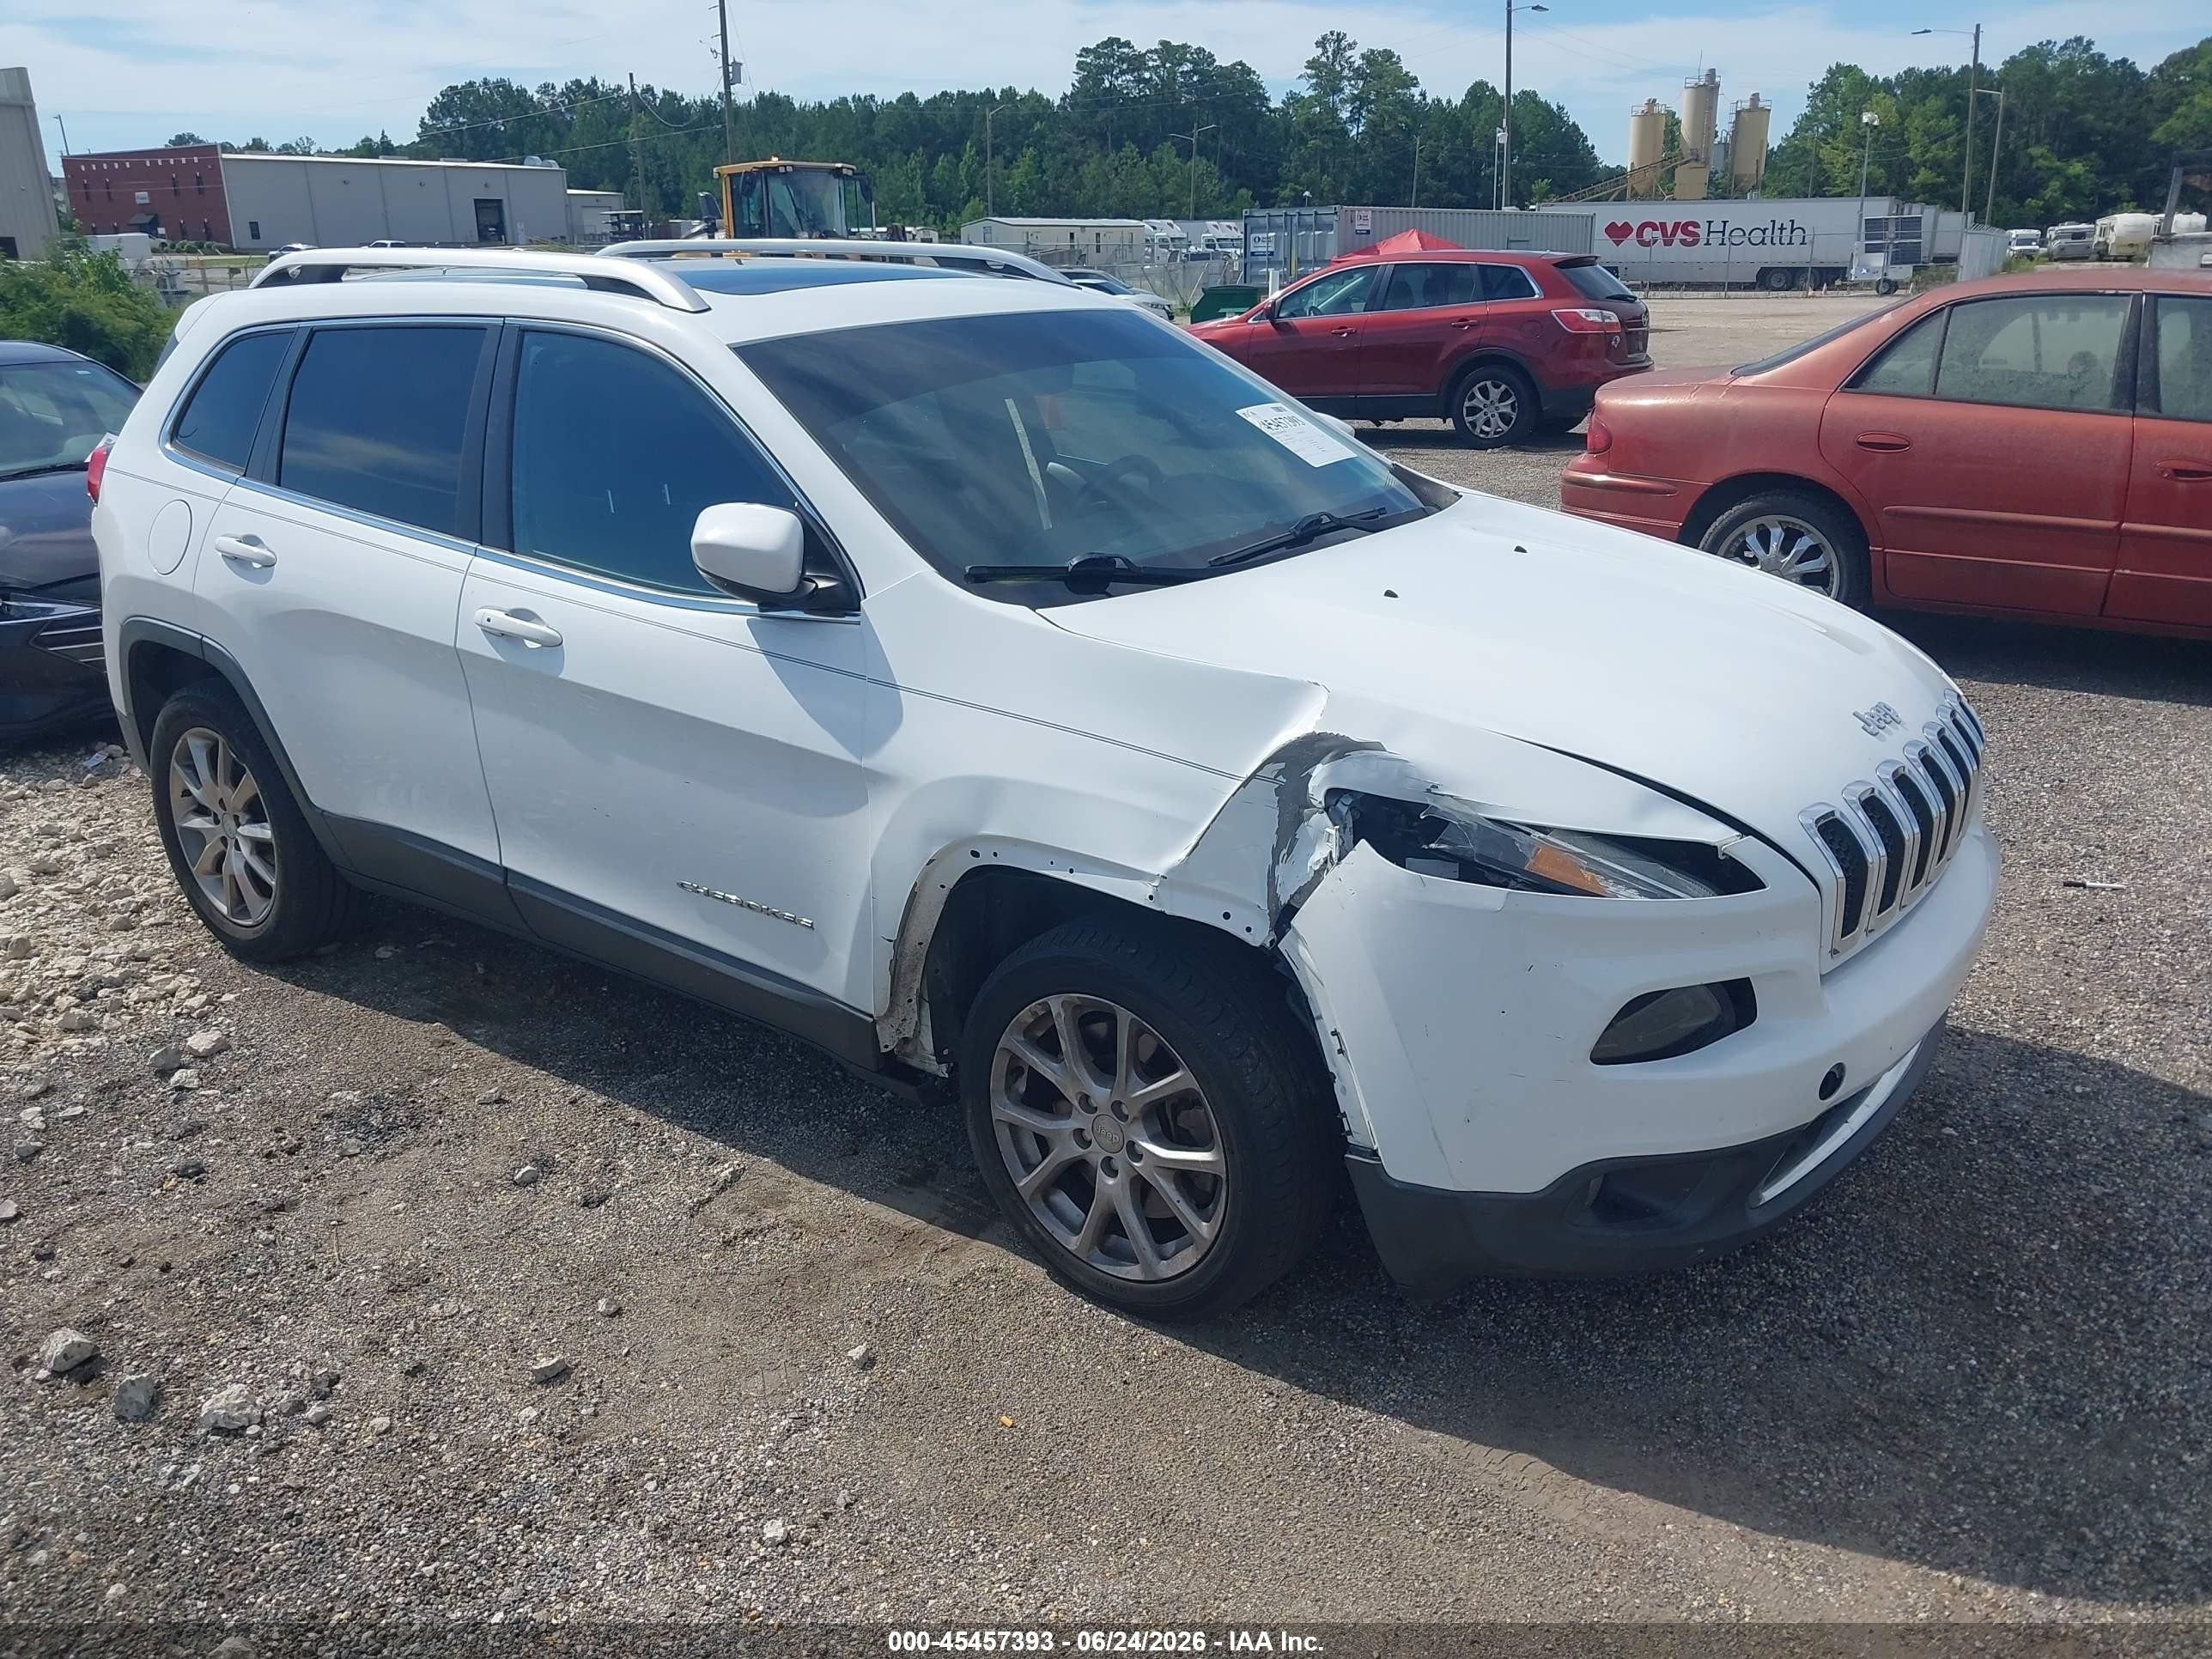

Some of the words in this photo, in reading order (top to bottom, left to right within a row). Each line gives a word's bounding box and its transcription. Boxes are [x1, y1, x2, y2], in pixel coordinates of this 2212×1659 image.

[1636, 221, 1701, 247] CVS
[1704, 220, 1808, 246] Health
[1852, 702, 1901, 736] Jeep
[677, 880, 815, 930] CHEROKEE
[1097, 1125, 1120, 1144] Jeep
